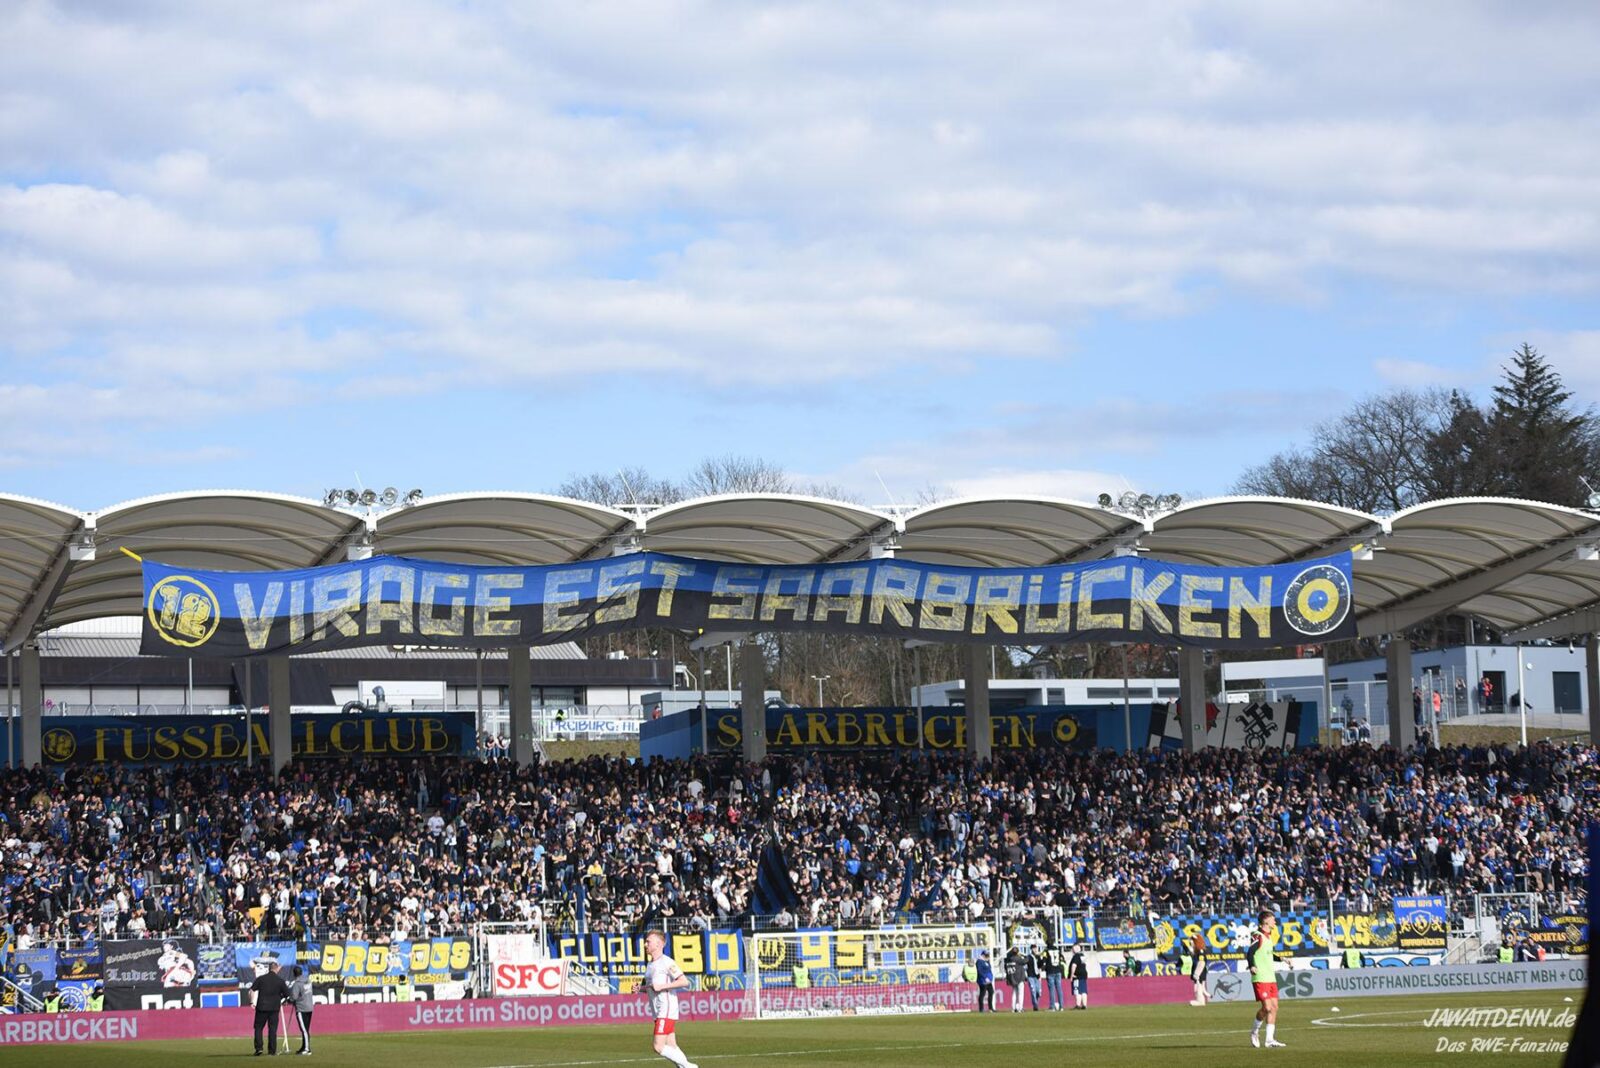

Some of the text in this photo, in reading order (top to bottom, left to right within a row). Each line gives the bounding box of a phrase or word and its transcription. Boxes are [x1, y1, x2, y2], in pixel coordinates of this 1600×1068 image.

[160, 584, 212, 639] 12
[234, 560, 1273, 650] VIRAGE EST SAARBRÜCKEN
[94, 717, 449, 762] FUSSBALCLUB
[879, 932, 988, 949] NORDSAAR
[915, 950, 956, 960] JUGEND
[496, 963, 561, 990] SFC
[1325, 970, 1528, 992] BAUSTOFFHANDELSGESELLSCHAFT
[1531, 969, 1557, 983] MBH
[409, 985, 1003, 1025] Jetzt im Shop oder unte elekom.de/glasfaser informiern
